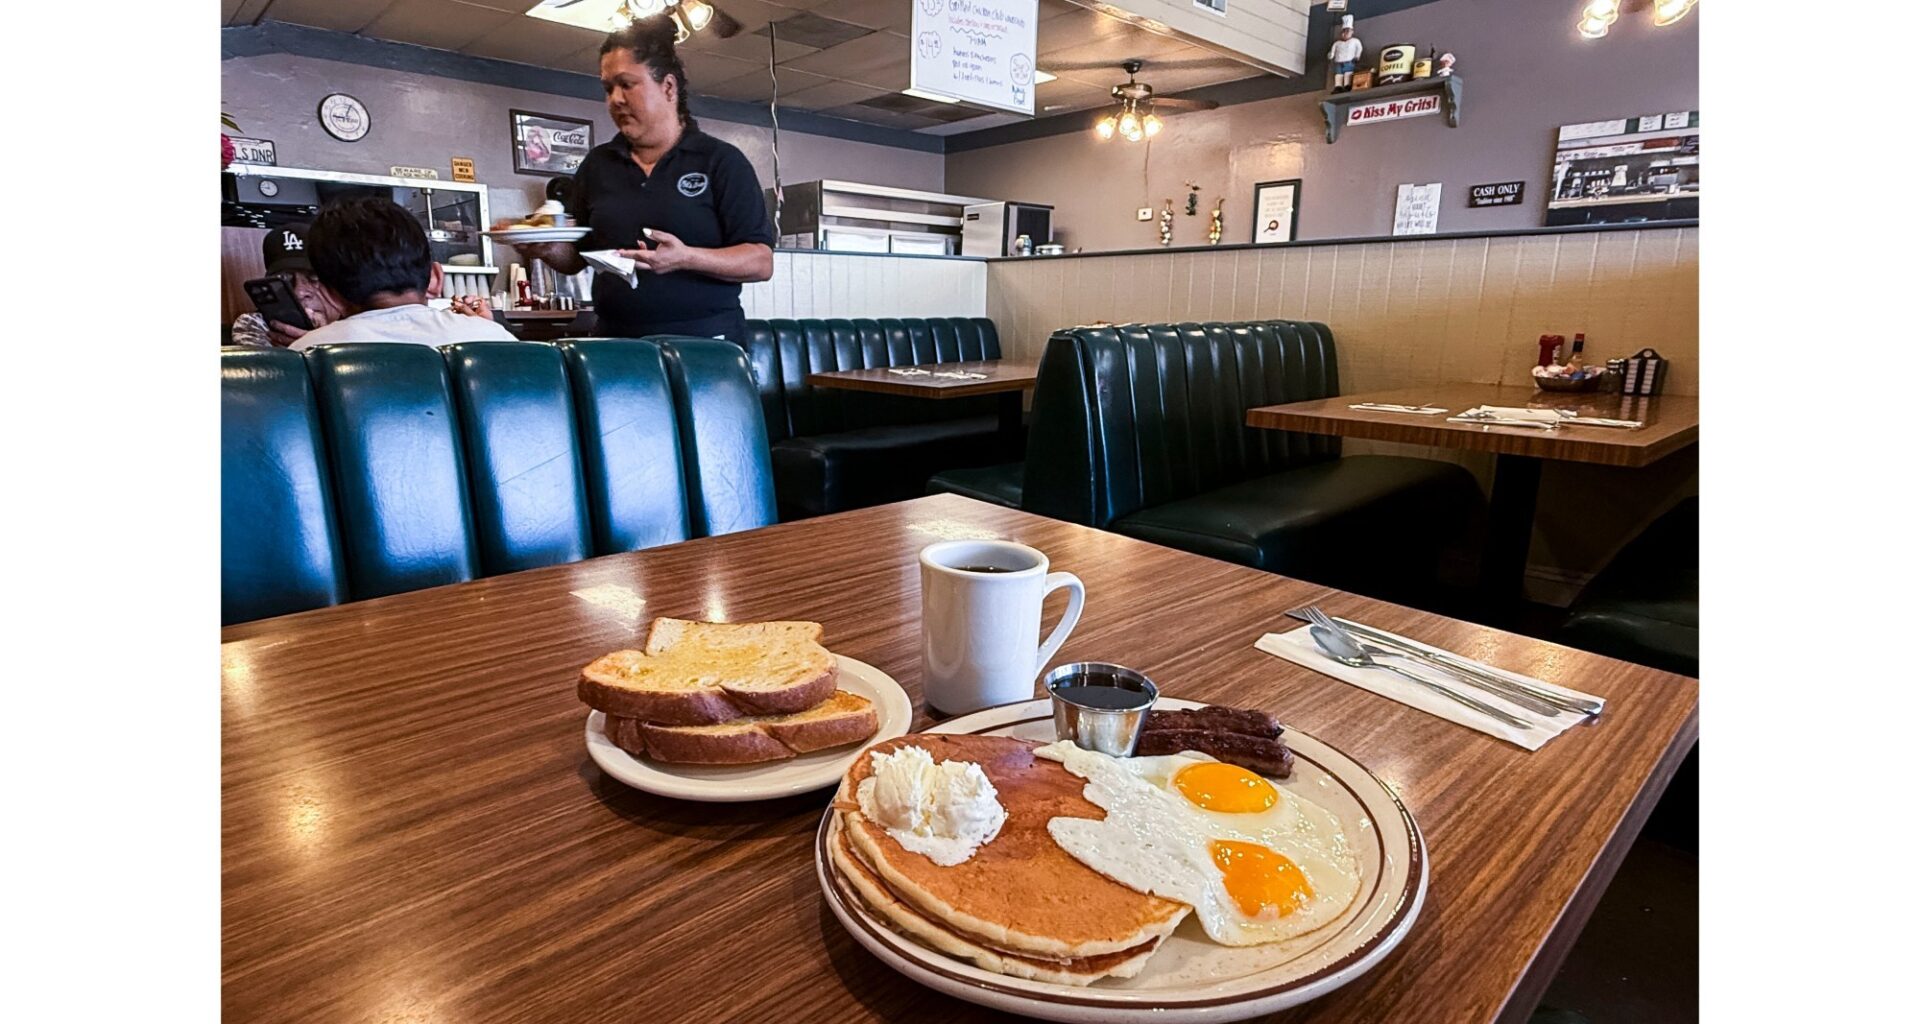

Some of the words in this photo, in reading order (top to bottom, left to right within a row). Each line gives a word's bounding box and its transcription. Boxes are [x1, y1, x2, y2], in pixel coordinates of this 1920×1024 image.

[1363, 106, 1386, 119] Kiss
[1387, 103, 1402, 117] My
[1404, 96, 1438, 113] Grits!
[251, 148, 273, 163] DNR
[1473, 185, 1496, 197] CASH
[1497, 183, 1520, 195] ONLY
[282, 230, 304, 250] LA
